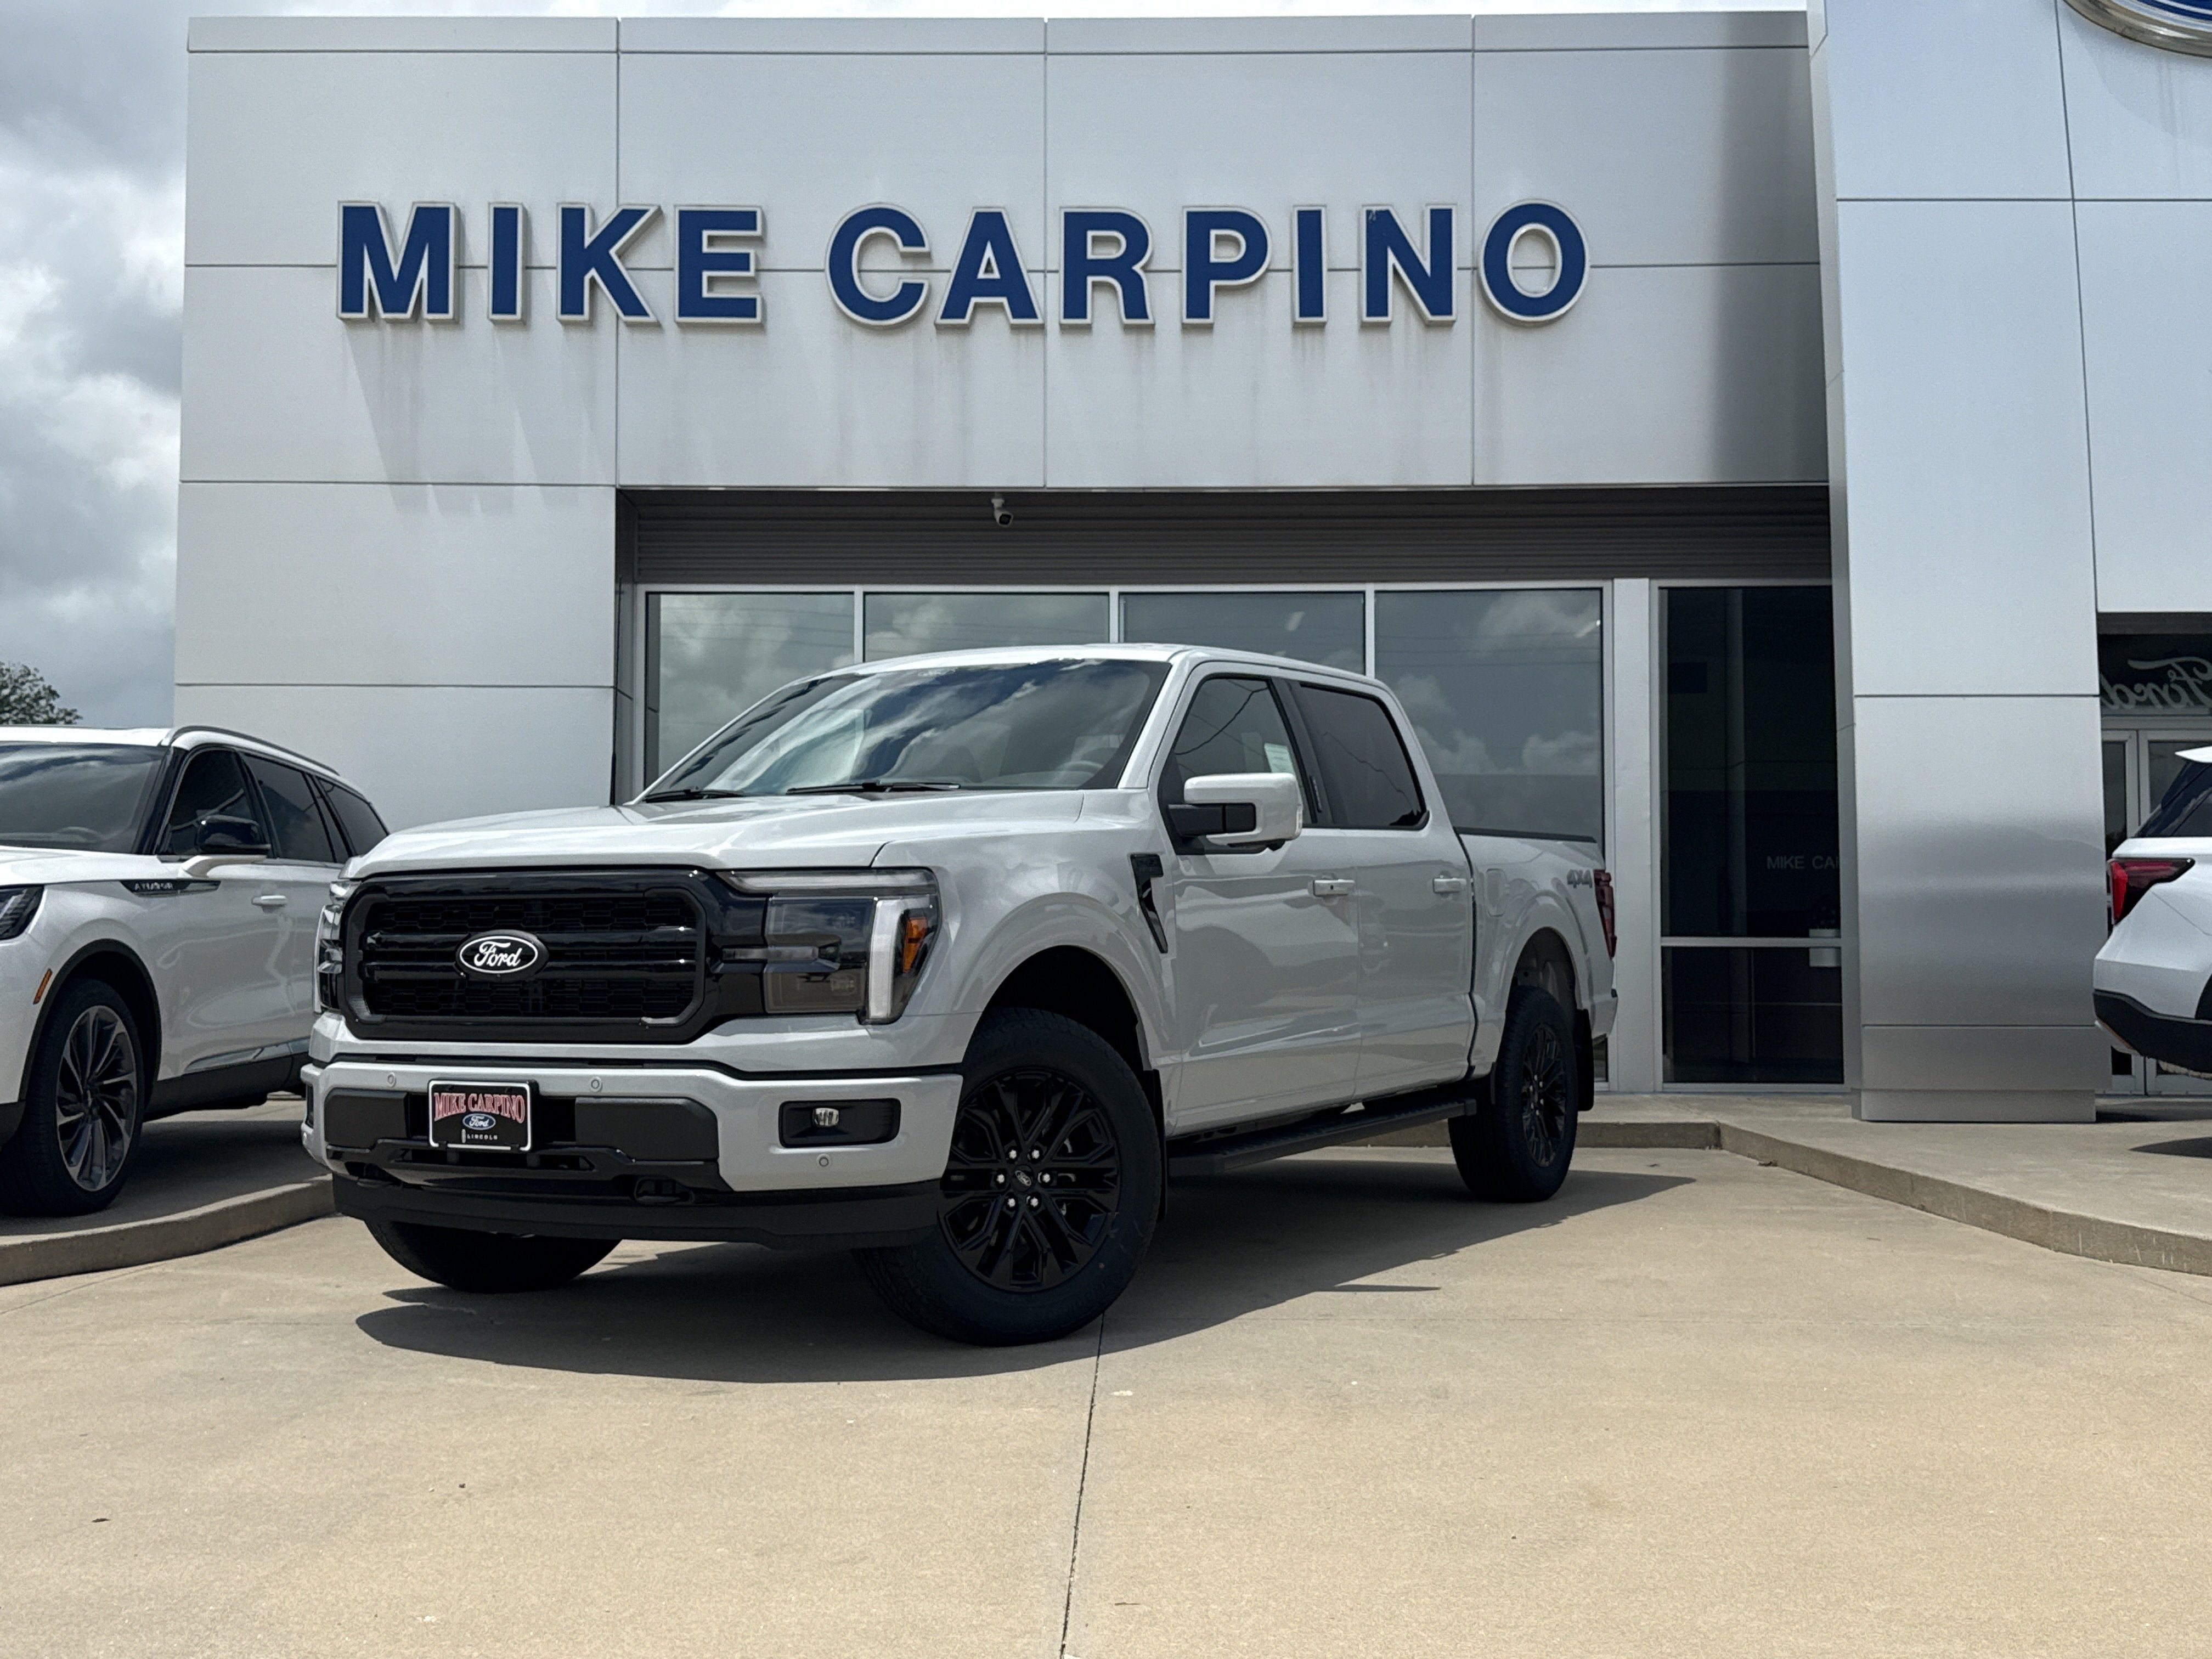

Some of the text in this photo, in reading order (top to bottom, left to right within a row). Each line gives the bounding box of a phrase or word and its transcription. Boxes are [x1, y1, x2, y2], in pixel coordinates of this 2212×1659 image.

[337, 199, 1590, 327] MIKE CARPINO
[1767, 856, 1805, 870] MIKE
[474, 941, 522, 967] Ford
[434, 1093, 525, 1124] MIKE CARPINO
[469, 1115, 489, 1127] Ford
